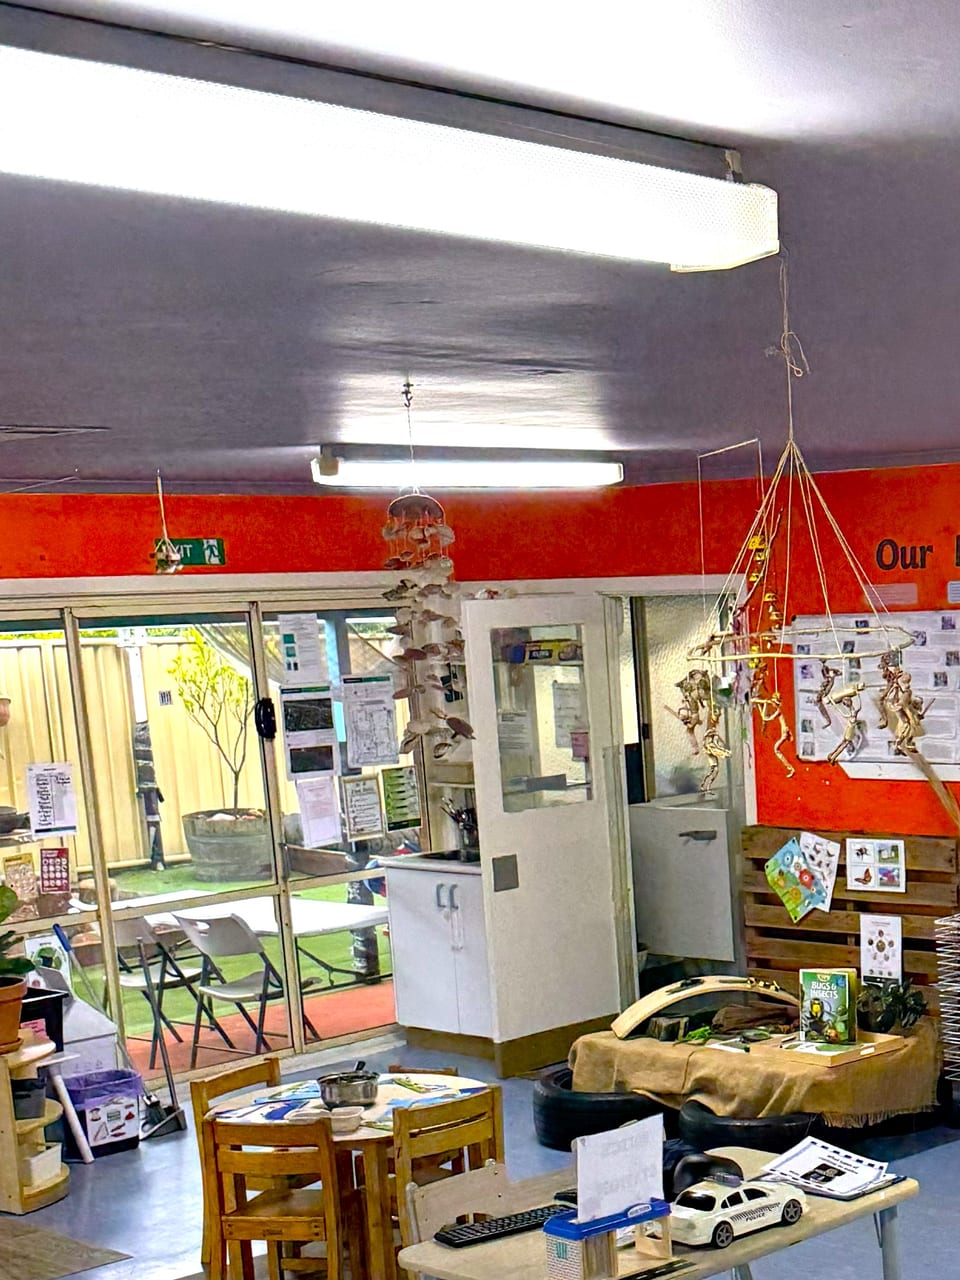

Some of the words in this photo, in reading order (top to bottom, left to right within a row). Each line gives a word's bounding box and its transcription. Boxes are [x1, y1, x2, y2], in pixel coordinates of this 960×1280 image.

[876, 538, 934, 571] Our
[811, 981, 831, 990] BUGS
[810, 988, 839, 1000] INSECTS
